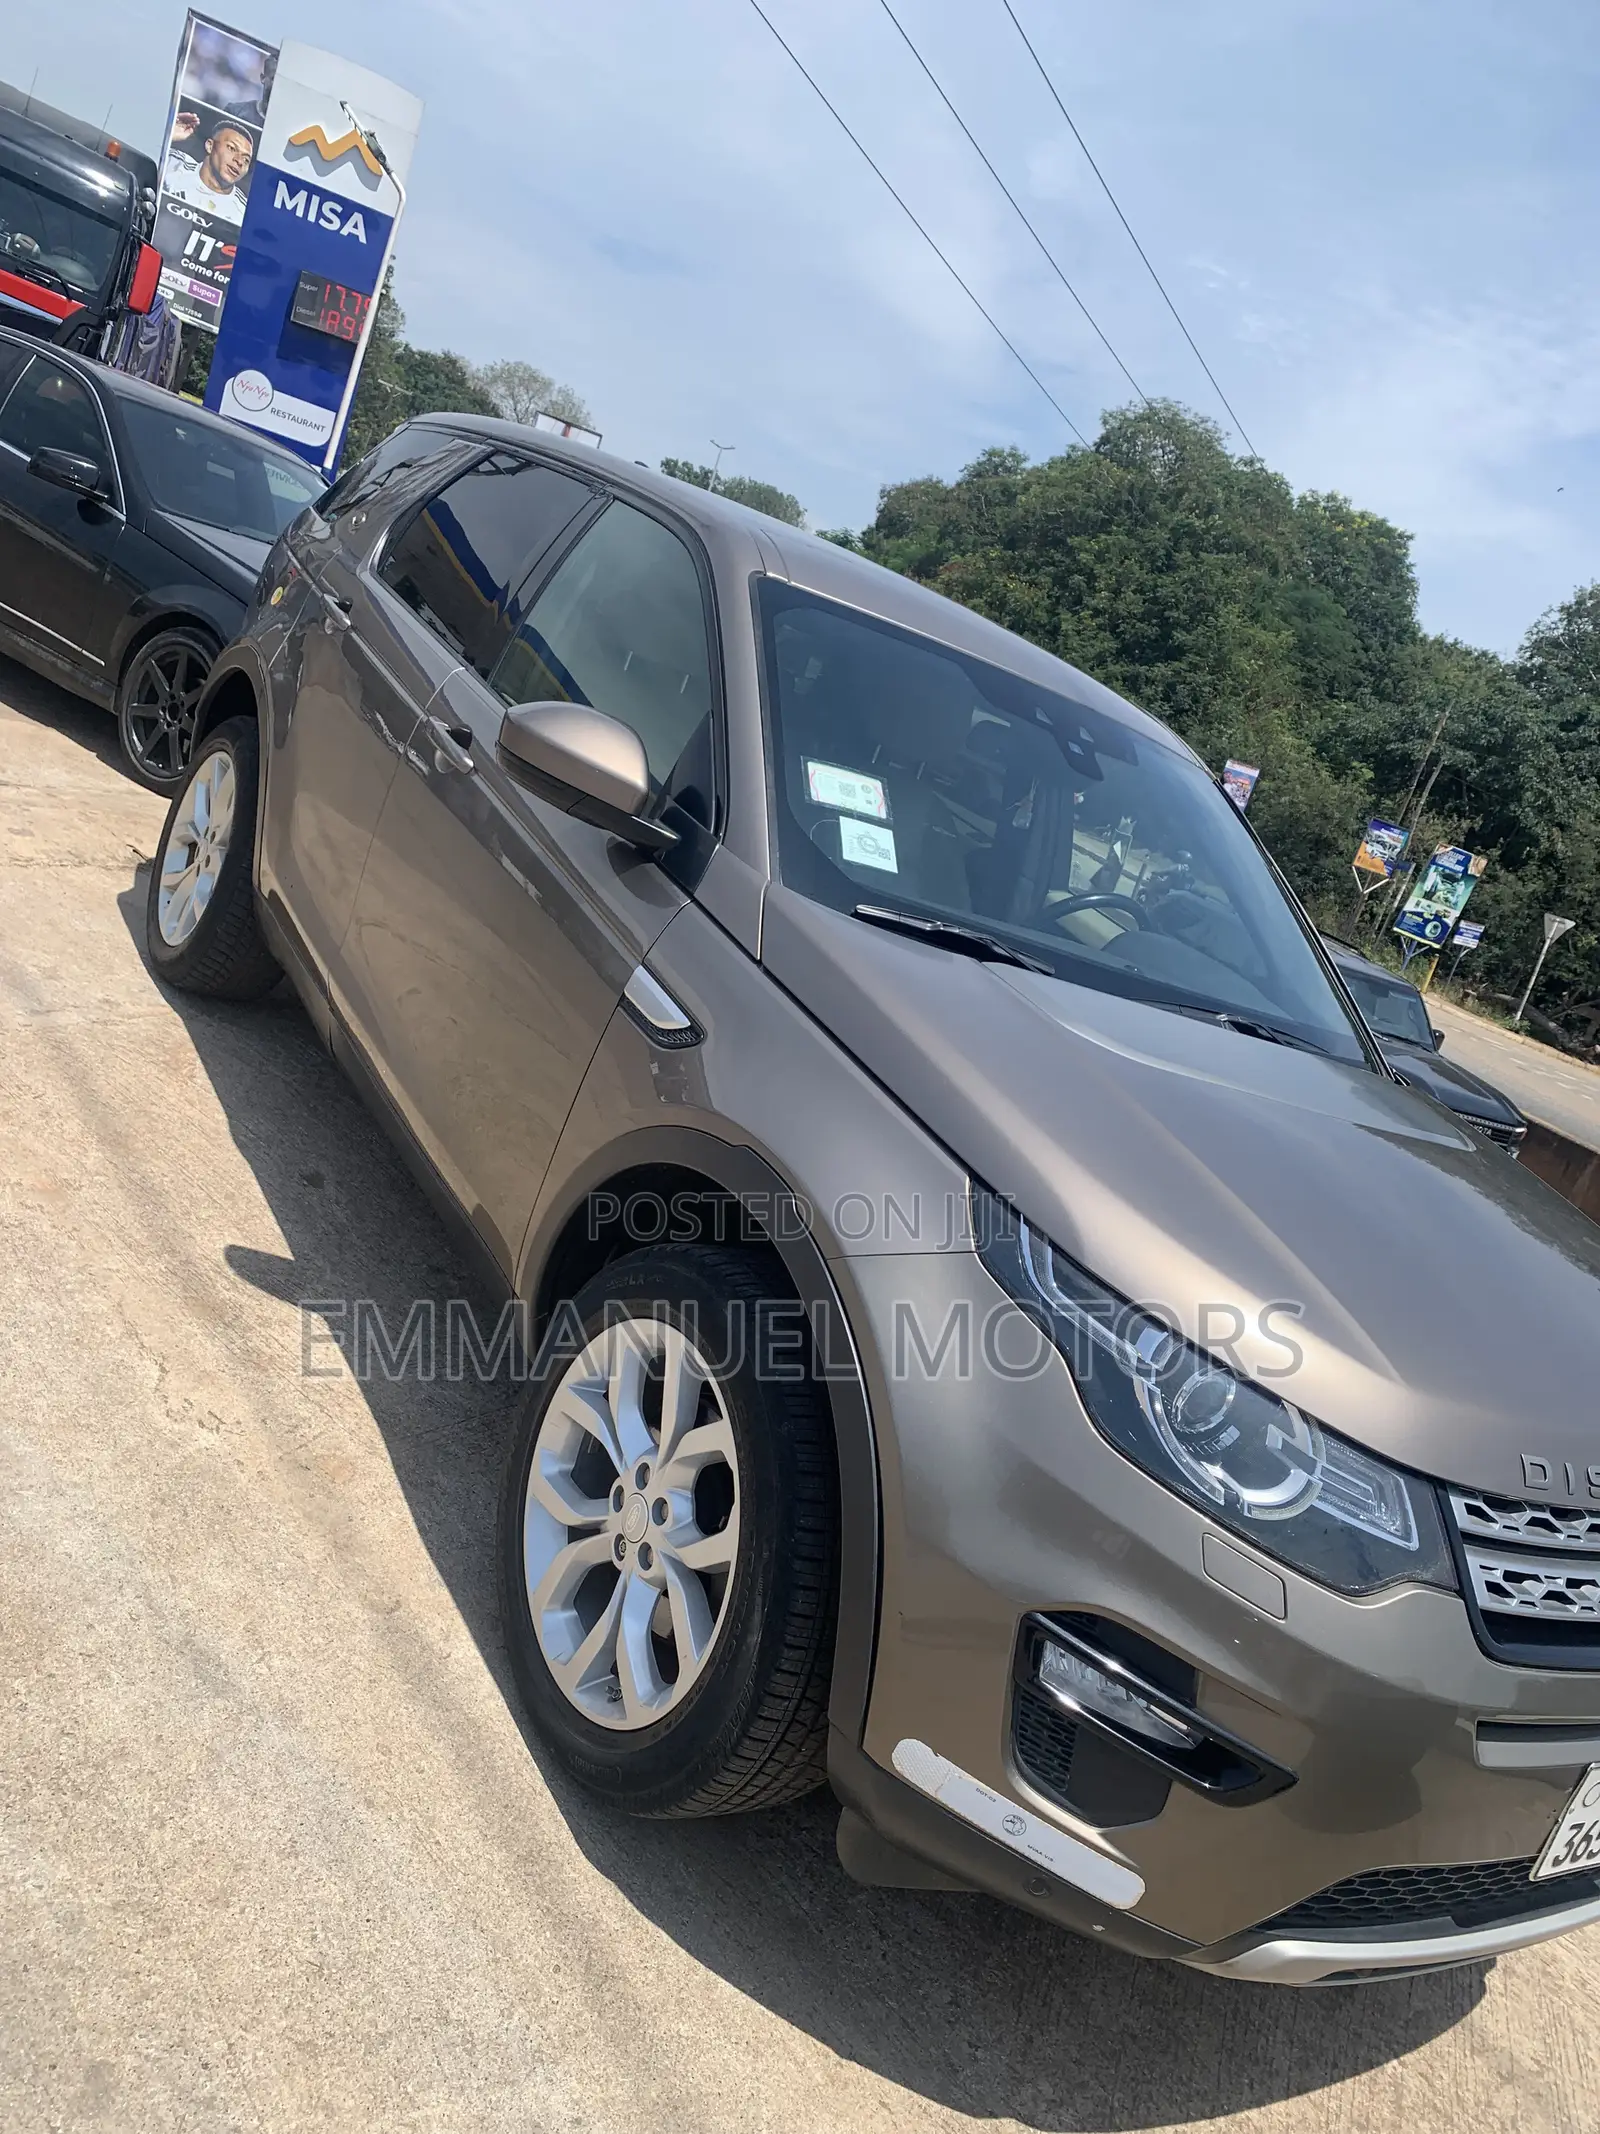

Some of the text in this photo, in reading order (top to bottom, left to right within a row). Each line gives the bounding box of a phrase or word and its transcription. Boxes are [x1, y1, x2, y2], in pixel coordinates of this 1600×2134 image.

[166, 202, 213, 228] GOtv
[274, 180, 367, 245] MISA
[180, 258, 231, 285] Come for
[192, 284, 216, 297] Supa+
[300, 281, 318, 292] Super
[270, 407, 327, 433] RESTAURANT
